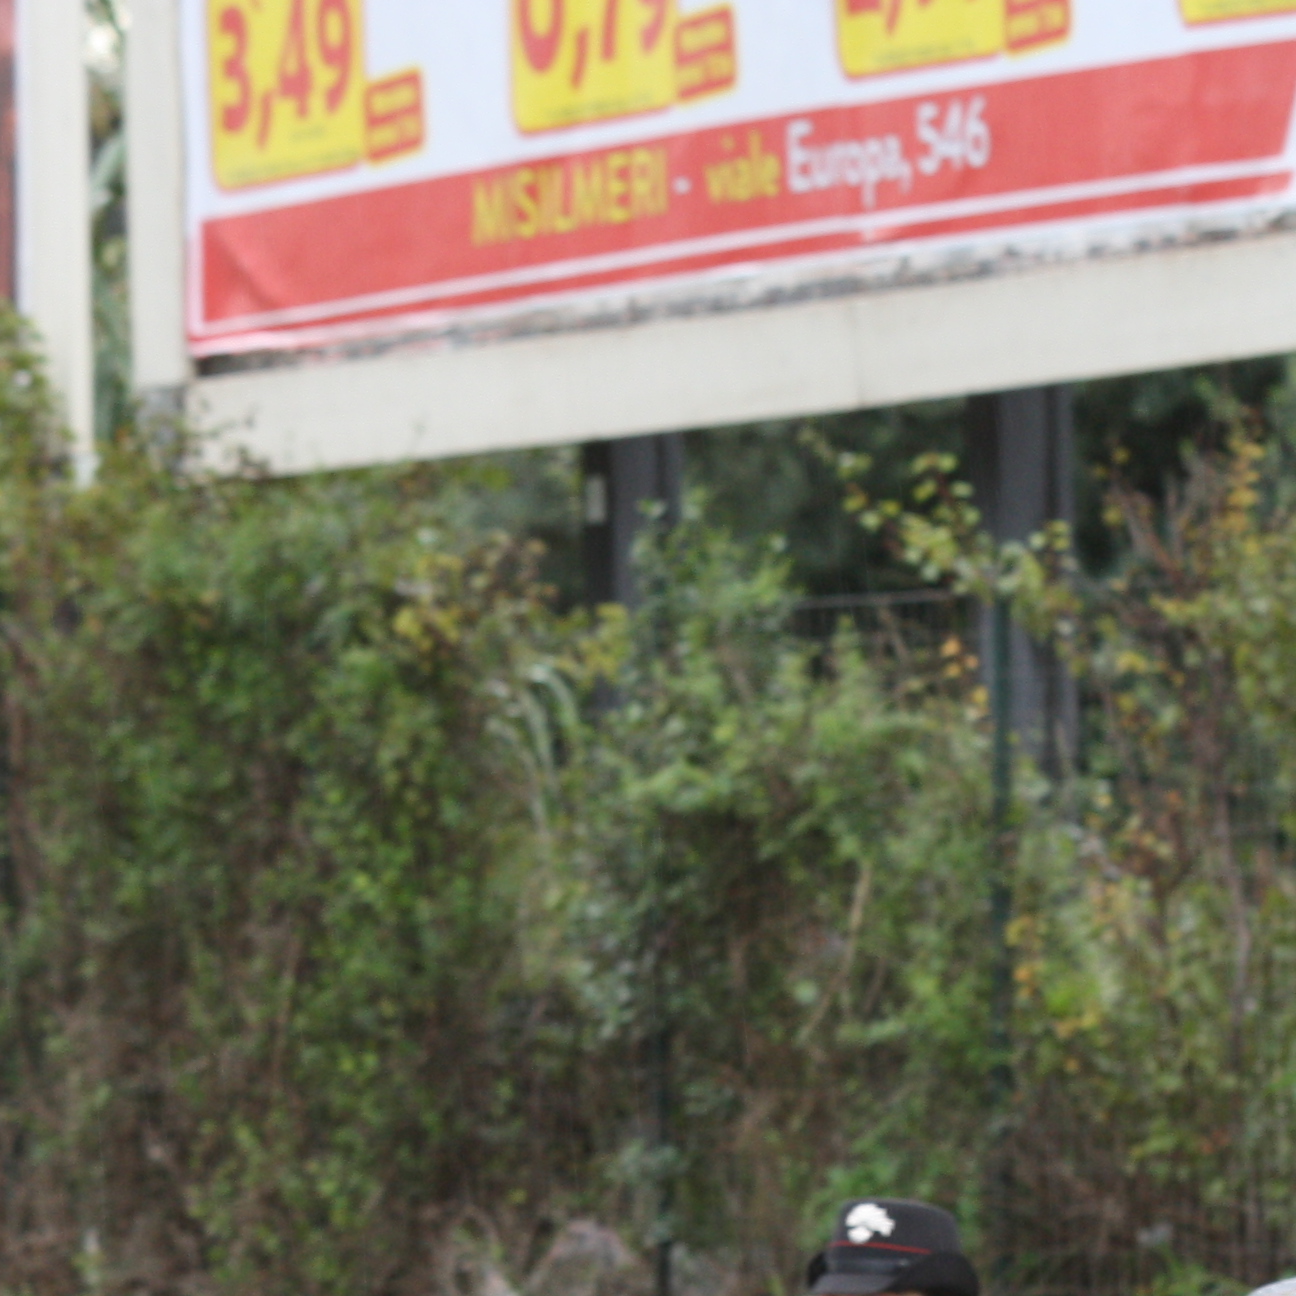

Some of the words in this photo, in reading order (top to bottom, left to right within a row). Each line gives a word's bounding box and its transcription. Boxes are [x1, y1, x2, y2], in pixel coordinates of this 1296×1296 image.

[471, 147, 669, 247] MISILMERI
[785, 118, 914, 210] Europa,
[916, 94, 991, 176] 546
